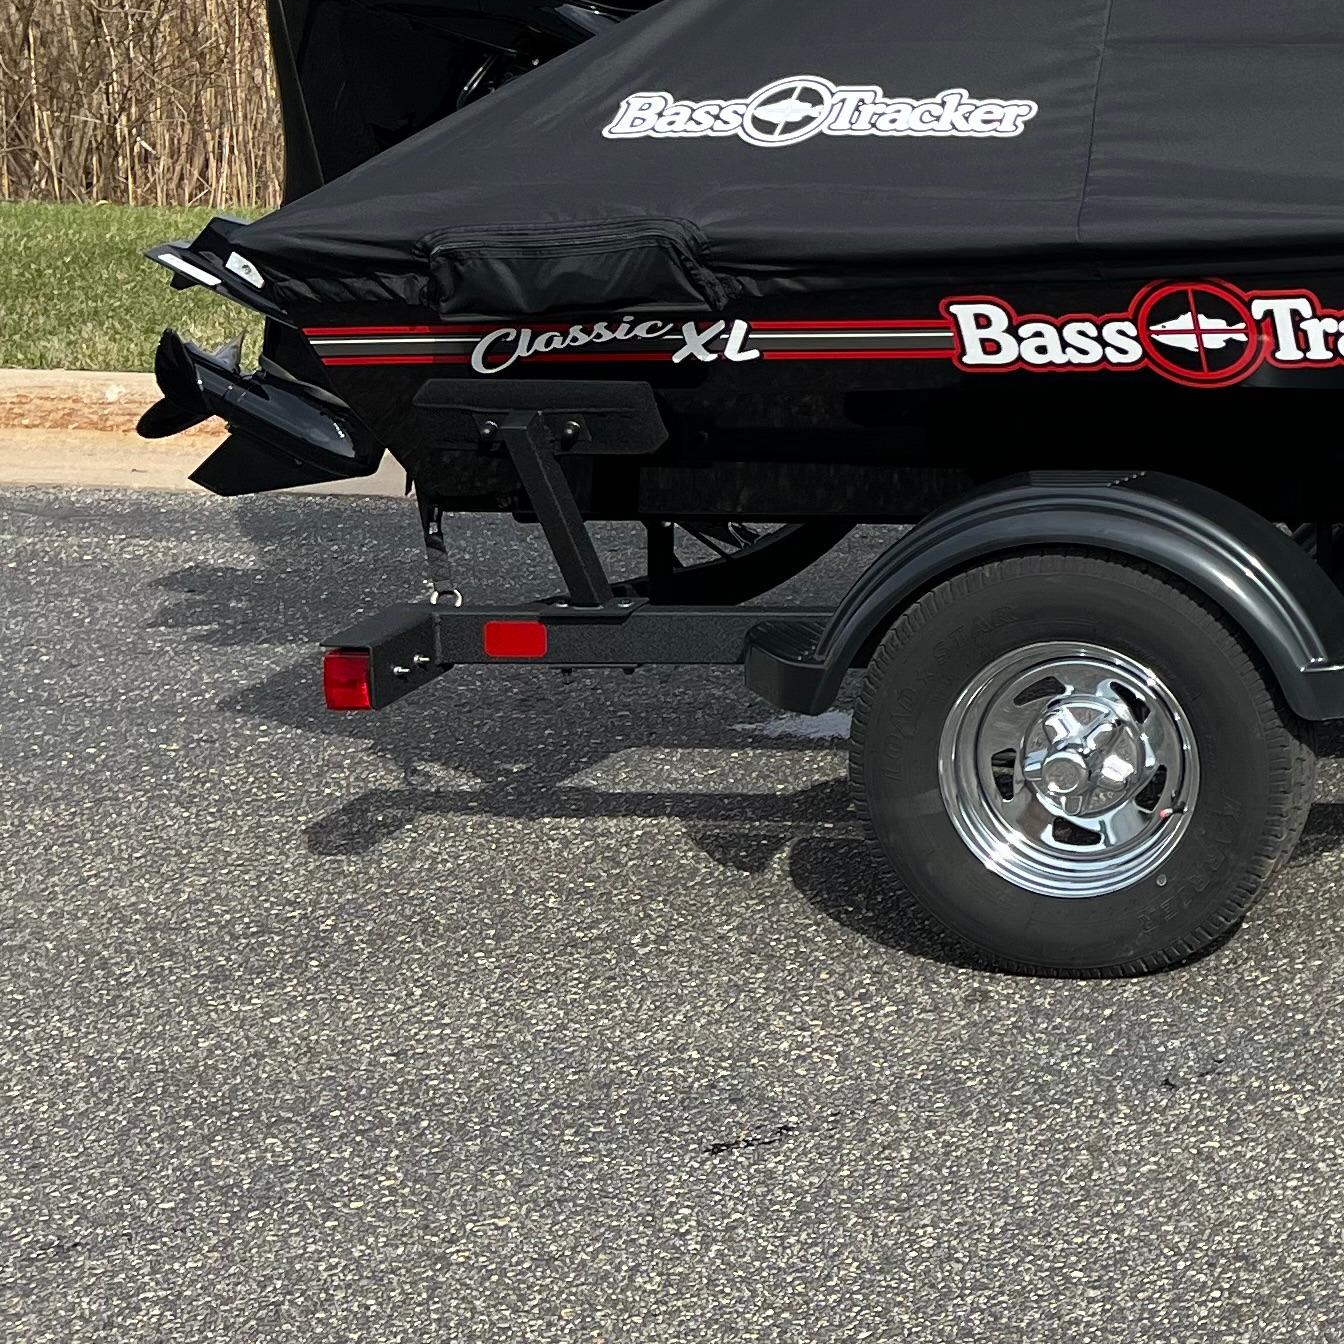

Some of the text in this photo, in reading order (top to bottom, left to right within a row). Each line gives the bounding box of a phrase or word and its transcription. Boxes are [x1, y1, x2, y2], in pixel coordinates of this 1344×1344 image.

[606, 87, 1035, 136] Bass Tracker
[471, 316, 760, 374] Classic XL
[949, 303, 1142, 364] Bass
